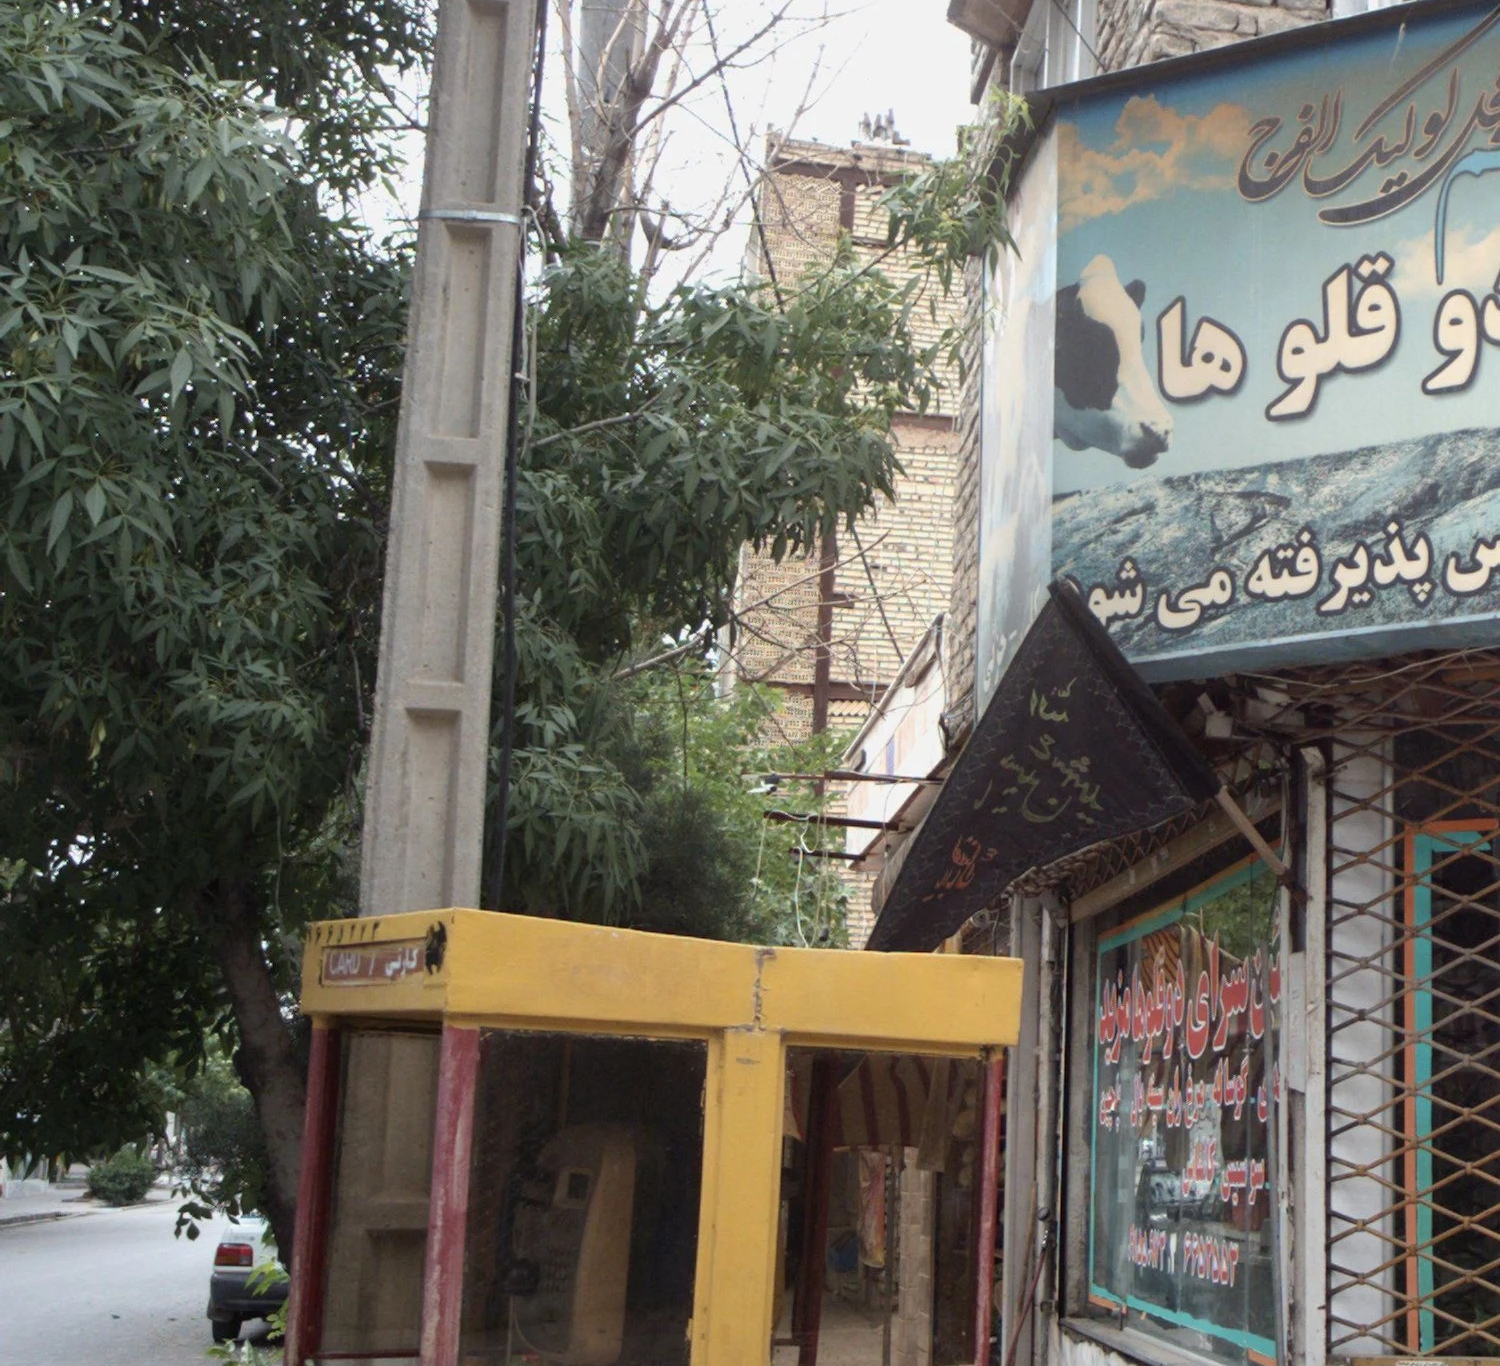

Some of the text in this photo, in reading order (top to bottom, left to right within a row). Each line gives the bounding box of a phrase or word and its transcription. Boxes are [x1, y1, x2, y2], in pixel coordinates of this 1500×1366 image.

[1072, 557, 1148, 629] شو
[1152, 573, 1237, 631] می
[1243, 520, 1437, 617] پذیرفته
